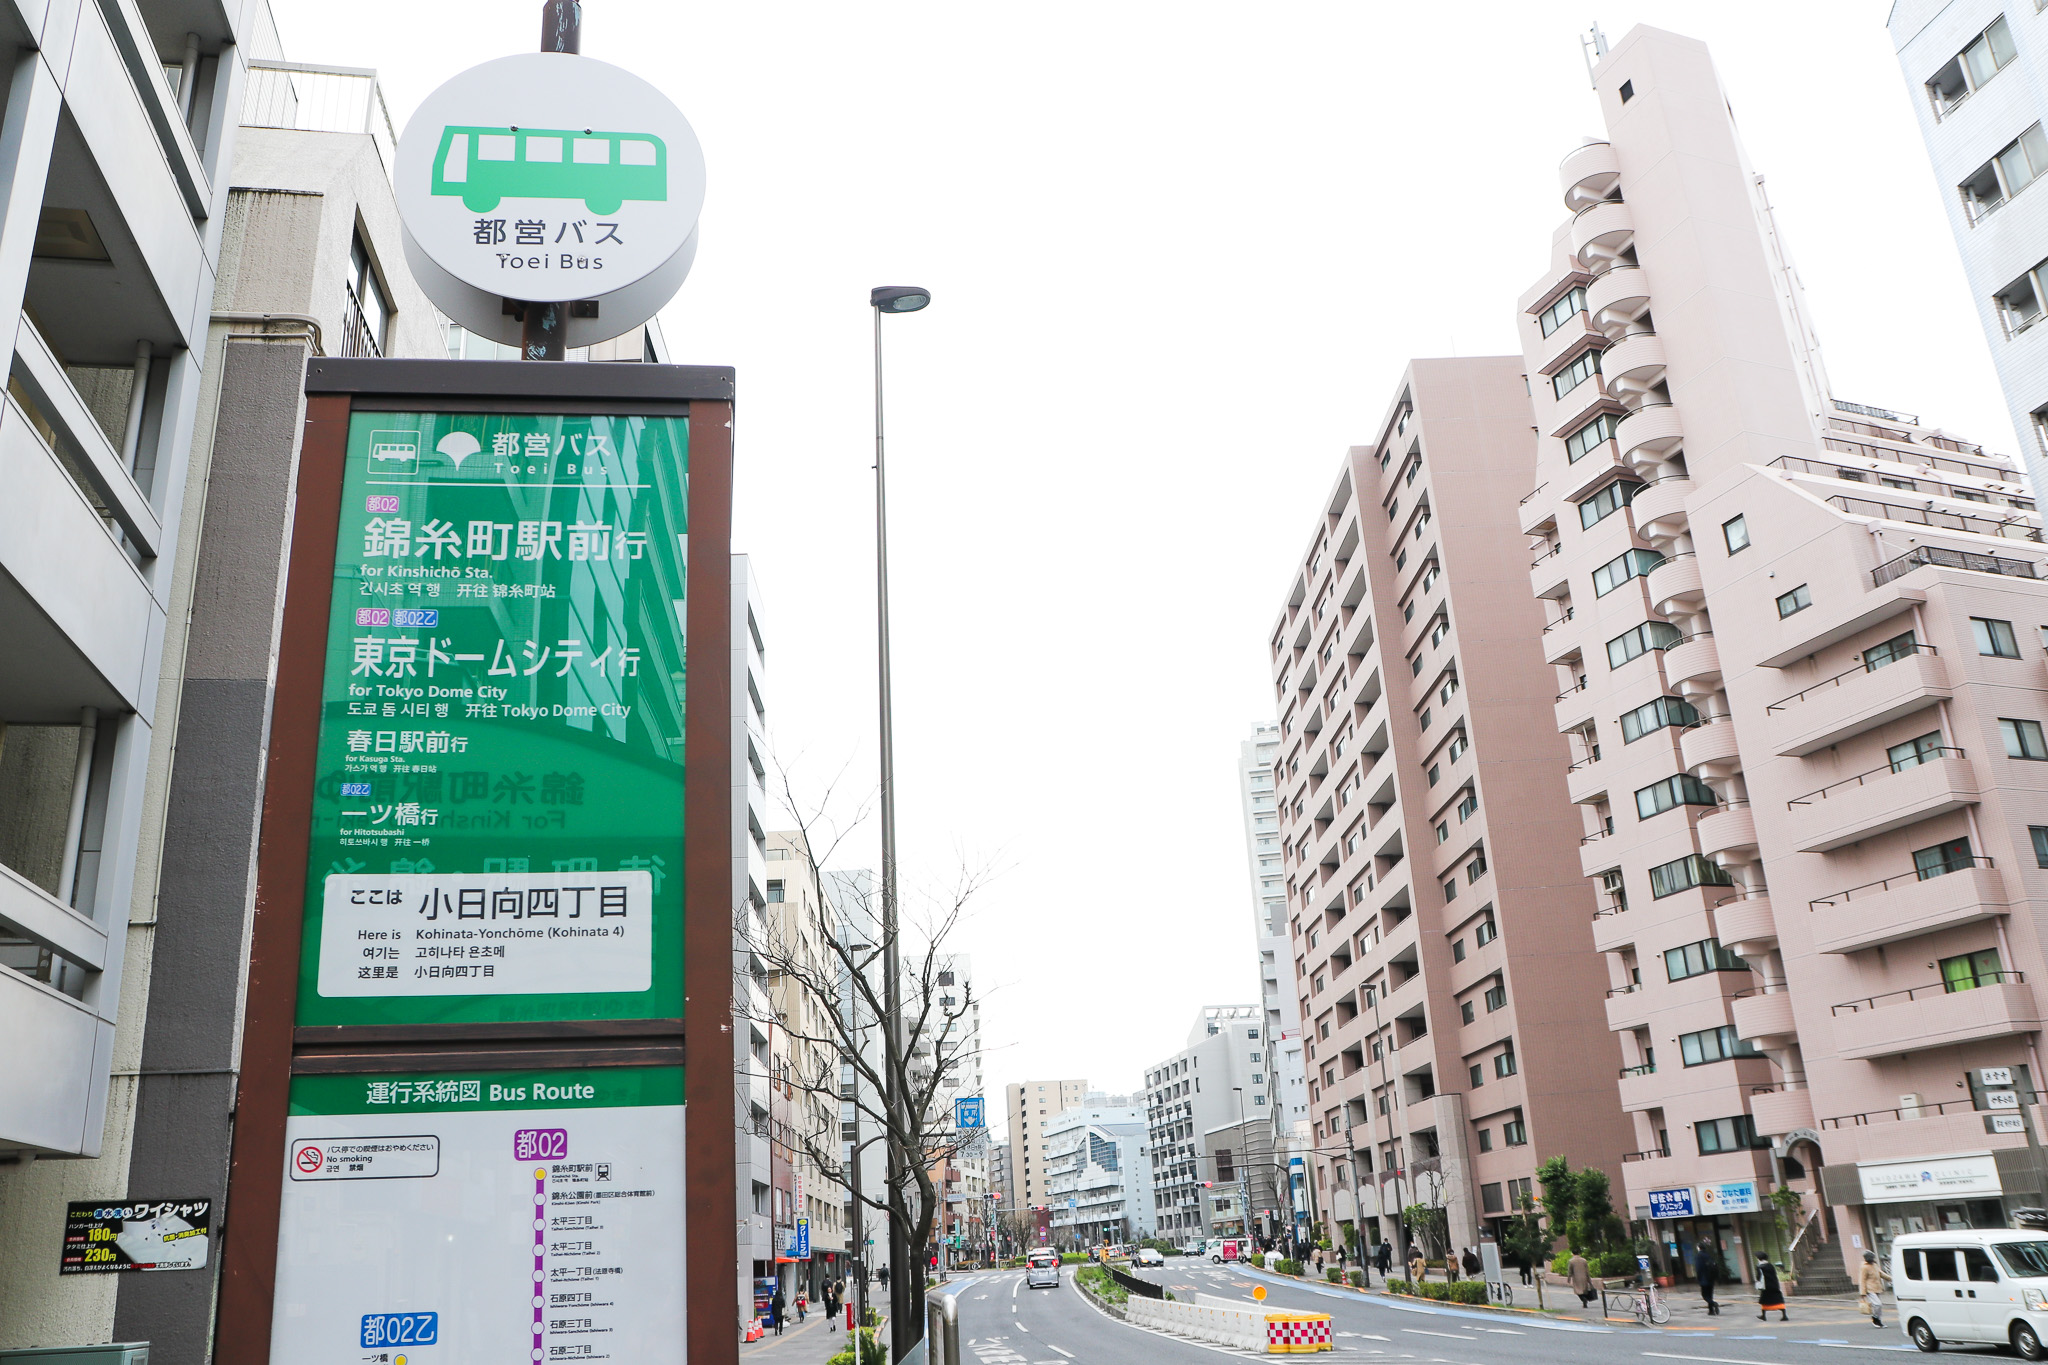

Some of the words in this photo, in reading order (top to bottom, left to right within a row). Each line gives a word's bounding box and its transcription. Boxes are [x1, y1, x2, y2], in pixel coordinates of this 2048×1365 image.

[473, 218, 624, 246] 都営バス
[496, 253, 549, 270] Toei
[560, 254, 603, 270] Bus
[491, 432, 612, 458] 都営バス
[494, 463, 549, 475] Toei
[567, 463, 608, 475] Bus
[367, 497, 398, 512] 都02
[363, 517, 647, 561] 錦糸町駅前行
[361, 565, 384, 578] for
[387, 565, 460, 578] Kinshichō
[465, 566, 493, 579] Sta.
[359, 582, 404, 597] 긴시초
[408, 582, 421, 597] 역
[426, 582, 440, 597] 행
[457, 583, 488, 598] 开往
[357, 609, 388, 626] 都02
[394, 610, 437, 626] 都02乙
[351, 635, 641, 678] 東京ドームシティ行
[349, 684, 372, 697] for
[376, 685, 424, 701] Tokyo
[428, 685, 473, 698] Dome
[477, 685, 508, 701] City
[347, 702, 378, 716] 도쿄
[382, 702, 397, 717] 돔
[400, 703, 430, 718] 시티
[434, 702, 449, 717] 행
[465, 703, 497, 718] 开往
[501, 703, 548, 719] Tokyo
[553, 704, 597, 717] Dome
[601, 703, 631, 719] City
[346, 729, 468, 754] 春日駅前行
[345, 755, 357, 763] for
[359, 755, 388, 764] Kasuga
[390, 755, 405, 763] Sta.
[341, 784, 371, 795] 都02乙
[341, 803, 438, 826] 一ツ橋行
[340, 828, 352, 836] for
[354, 828, 404, 836] Hitotsubashi
[350, 889, 403, 905] ここは
[418, 886, 628, 920] 小日向四丁目
[358, 930, 387, 940] Here
[391, 929, 401, 940] is
[416, 927, 544, 940] Kohinata-Yonchōme
[547, 926, 609, 940] (Kohinata
[613, 926, 625, 939] 4)
[363, 947, 400, 960] 여기는
[415, 946, 465, 959] 고히나타
[468, 945, 505, 959] 욘초메
[357, 966, 399, 979] 这里是
[414, 965, 495, 979] 小日向四丁目
[366, 1080, 480, 1106] 運行系統図
[489, 1084, 526, 1102] Bus
[533, 1083, 595, 1101] Route
[327, 1144, 434, 1153] バス停での喫煙はおやめください
[516, 1131, 565, 1159] 都02
[340, 1155, 372, 1164] smoking
[134, 1202, 209, 1219] ワイシャツ
[551, 1216, 592, 1226] 太平三丁目
[88, 1228, 117, 1242] 180円
[551, 1242, 592, 1251] 太平二丁目
[84, 1248, 117, 1262] 230円
[550, 1293, 592, 1303] 石原四丁目
[363, 1315, 435, 1346] 都02乙
[550, 1319, 592, 1329] 石原三丁目
[549, 1345, 591, 1355] 石原二丁目
[362, 1354, 388, 1363] 一ツ橋
